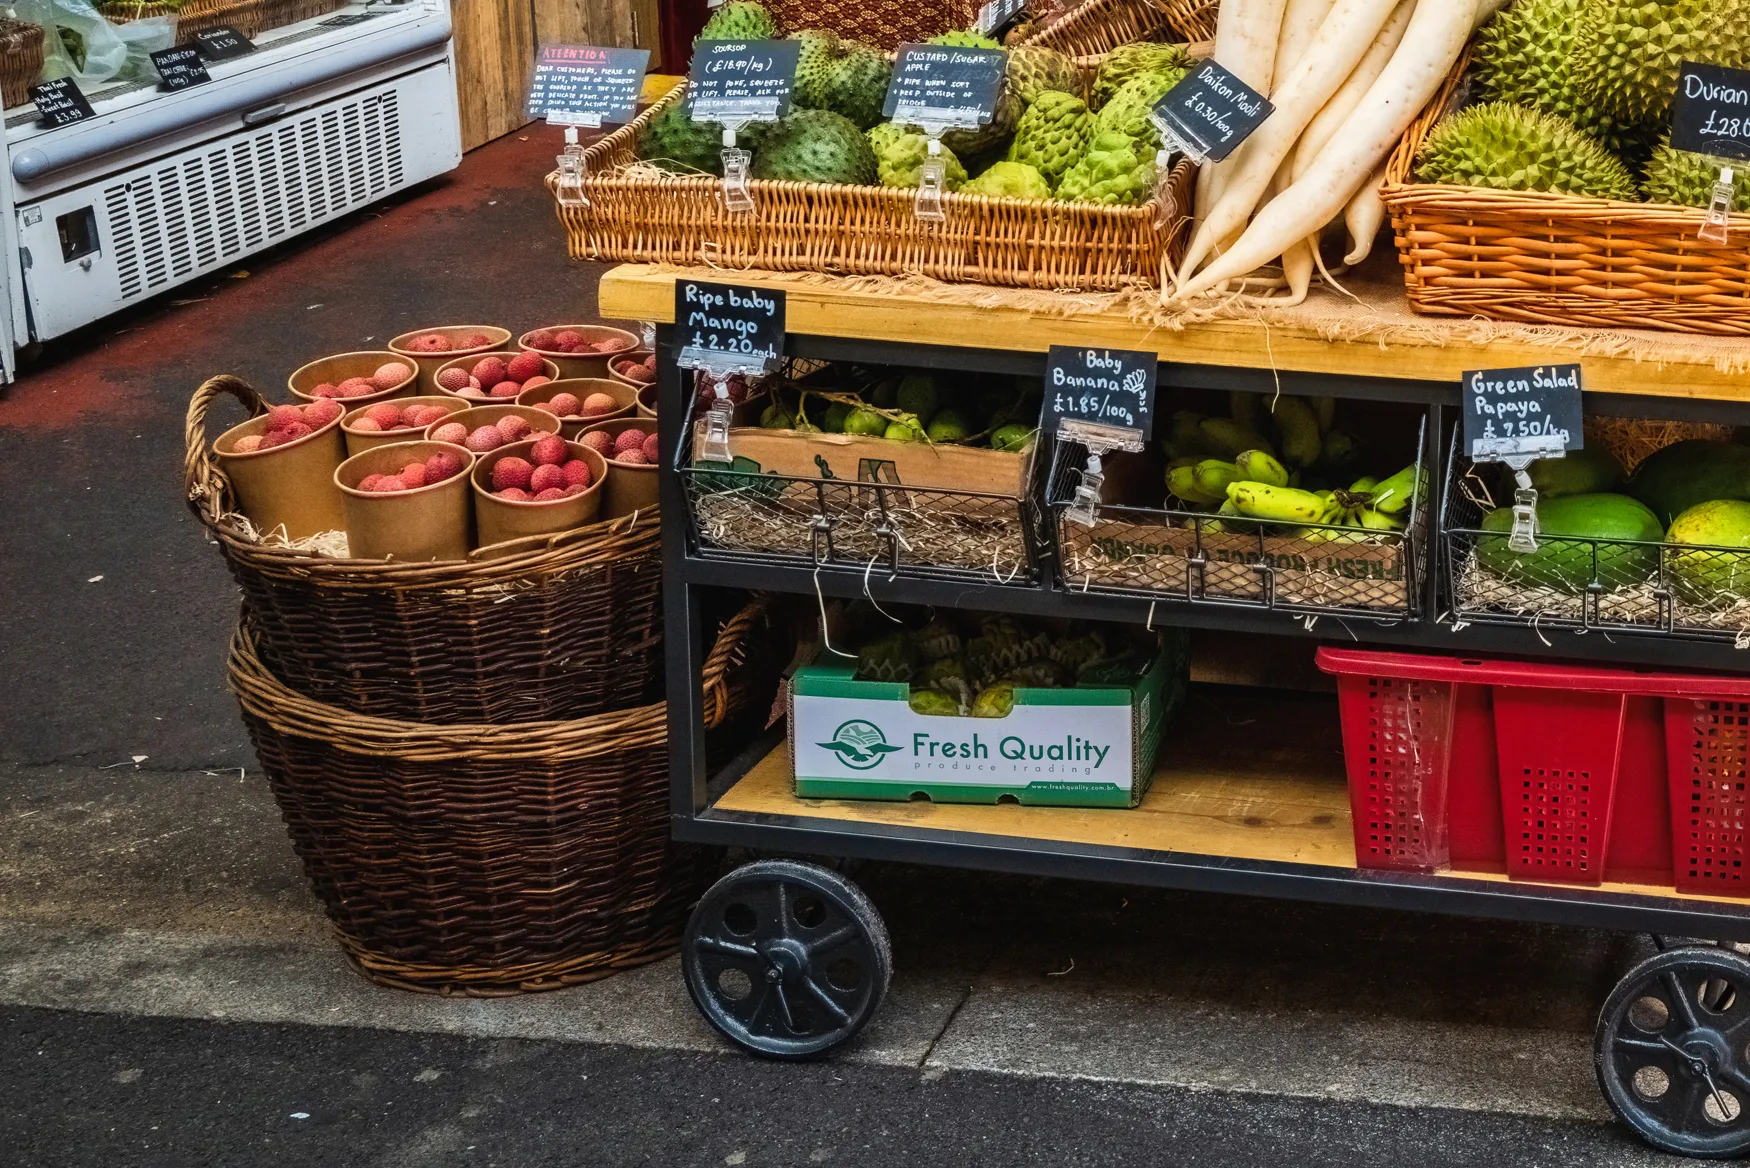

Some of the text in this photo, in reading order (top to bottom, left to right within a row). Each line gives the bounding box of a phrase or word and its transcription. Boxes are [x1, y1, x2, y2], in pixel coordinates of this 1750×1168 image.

[213, 39, 238, 50] £1.50
[712, 45, 746, 53] SOURSOP
[907, 51, 947, 61] CUSTARD
[905, 64, 931, 72] APPLE
[52, 80, 67, 90] Fresh
[1198, 66, 1261, 117] Daikon Mooli
[1684, 74, 1748, 105] Durian
[55, 108, 83, 124] £3.99
[685, 284, 775, 316] Ripe baby
[689, 312, 758, 339] Mango
[1087, 350, 1122, 374] Baby
[1053, 367, 1120, 392] Banana
[1472, 367, 1578, 394] Green Salad
[1054, 393, 1133, 426] £1.85/100g
[1475, 396, 1541, 419] Papaya
[913, 733, 1111, 769] Fresh Quality
[914, 761, 1091, 776] produce trading
[1031, 783, 1115, 792] www.freshquality.com.br
